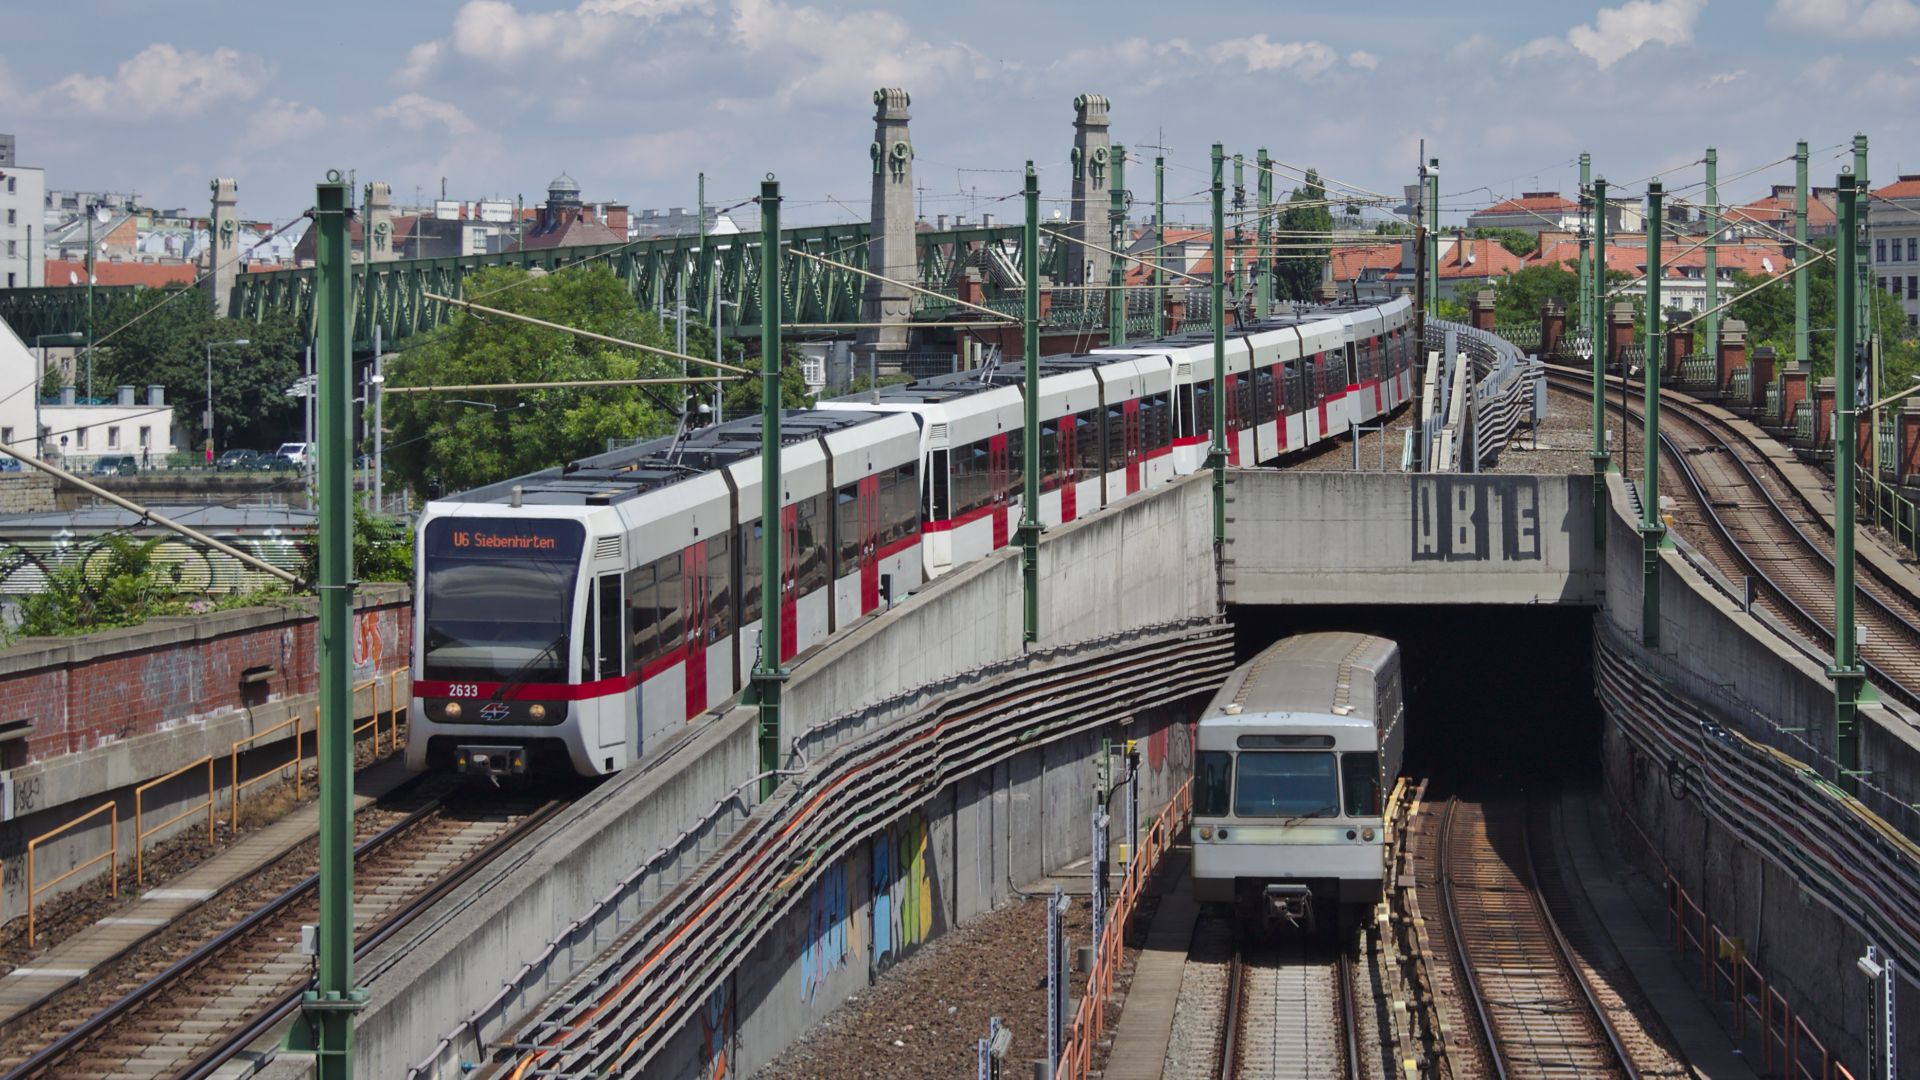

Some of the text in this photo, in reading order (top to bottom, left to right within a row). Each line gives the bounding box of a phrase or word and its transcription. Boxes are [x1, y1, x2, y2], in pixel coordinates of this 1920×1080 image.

[454, 532, 555, 548] U6 Siebenhirten
[449, 684, 478, 697] 2633
